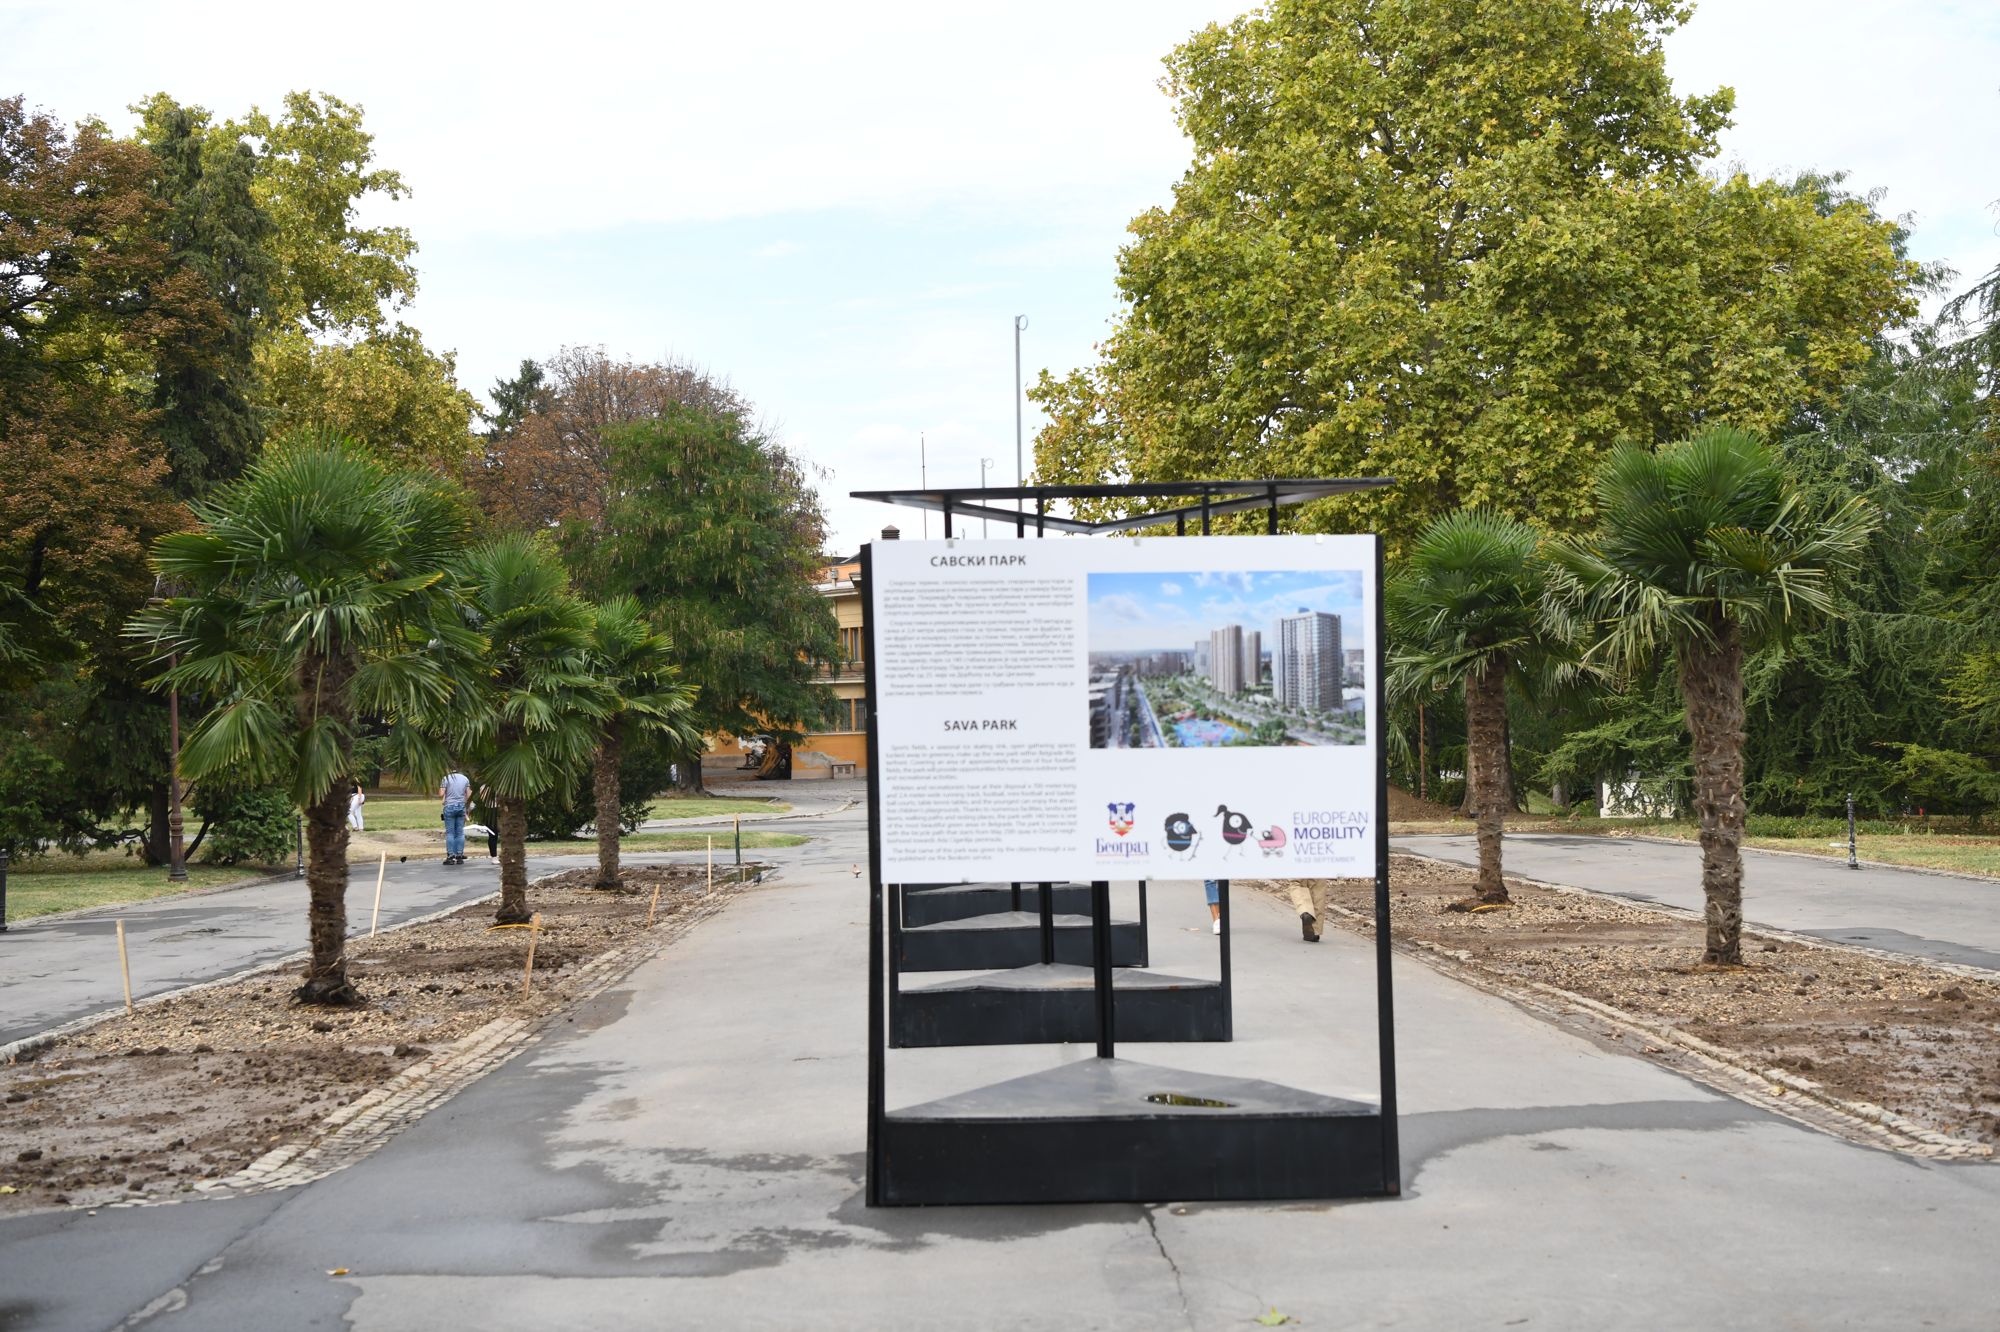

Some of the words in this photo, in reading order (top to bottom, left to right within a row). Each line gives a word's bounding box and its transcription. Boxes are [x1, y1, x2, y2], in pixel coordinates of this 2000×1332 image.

[930, 555, 986, 567] САВСКИ
[989, 555, 1027, 566] ПАРК
[944, 719, 979, 731] SAVA
[982, 719, 1018, 730] PARK
[1293, 811, 1368, 825] EUROPEAN
[1294, 826, 1366, 840] MOBILITY
[1095, 838, 1150, 858] Београд
[1293, 841, 1334, 855] WEEK
